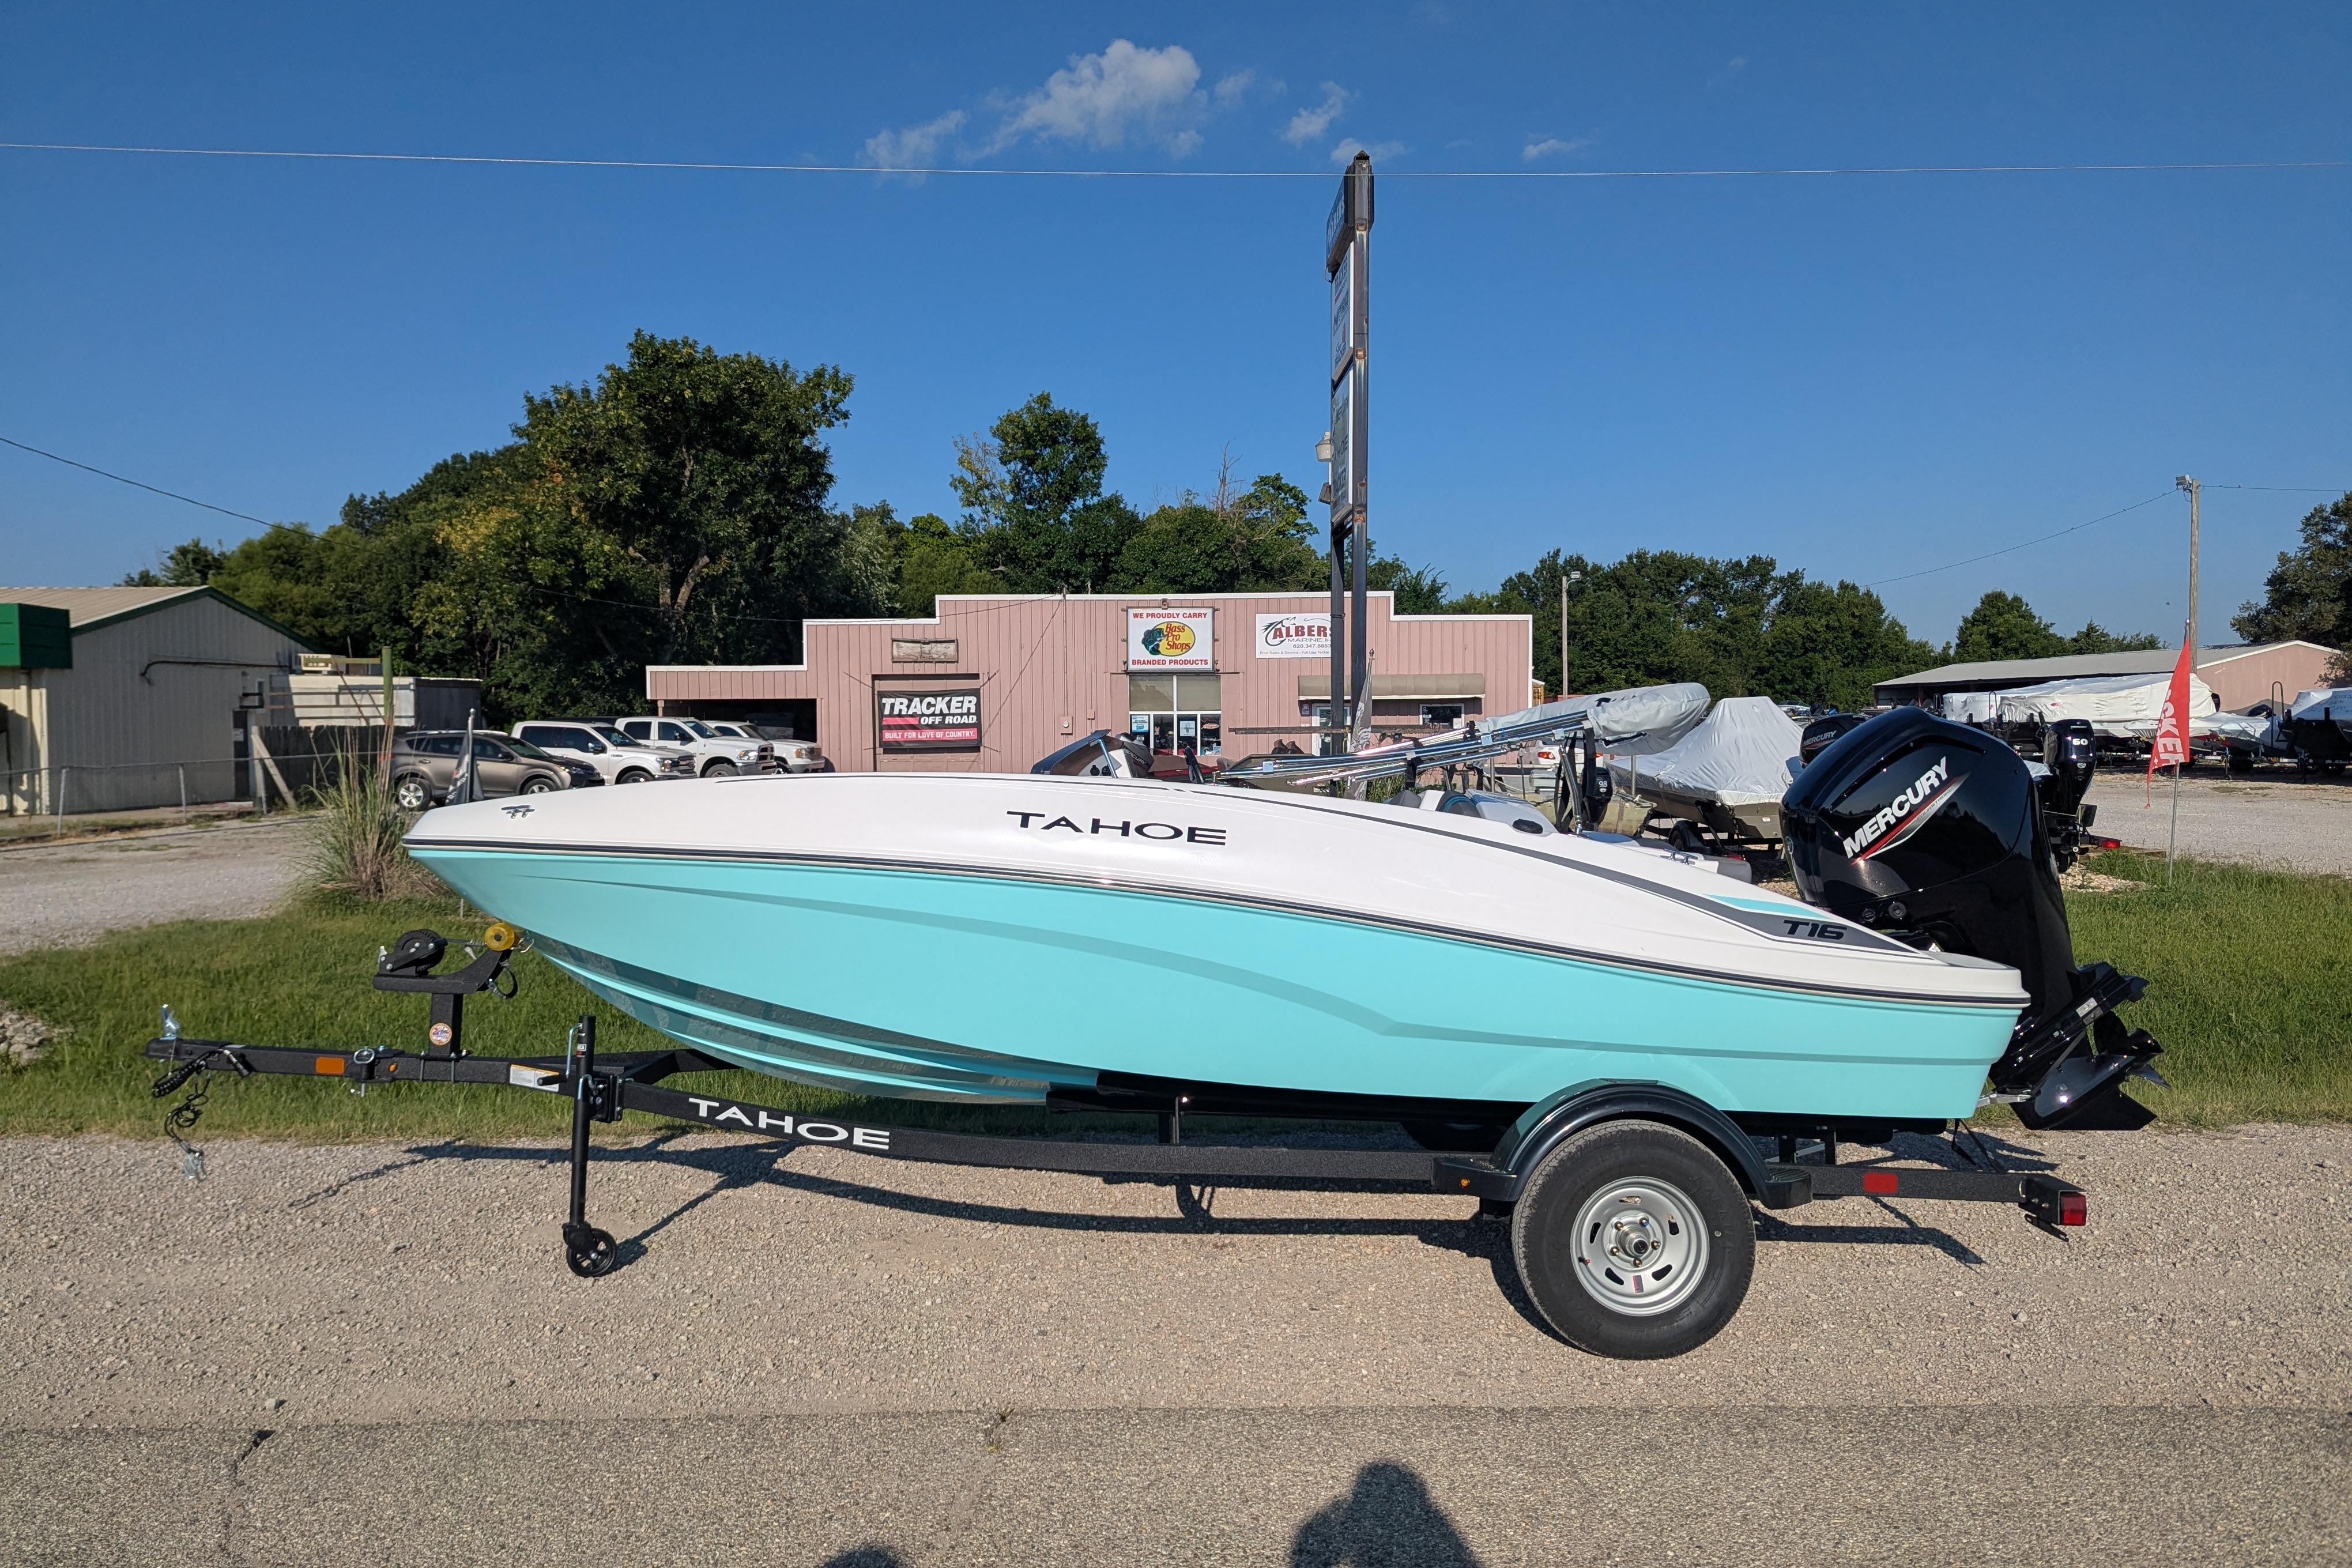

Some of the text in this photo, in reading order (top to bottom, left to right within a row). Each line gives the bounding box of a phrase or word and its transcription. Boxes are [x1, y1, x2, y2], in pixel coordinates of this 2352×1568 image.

[1165, 623, 1186, 633] Bass
[1272, 625, 1331, 640] ALBER
[1166, 632, 1181, 642] Pro
[1166, 640, 1191, 651] Shops
[881, 696, 977, 715] TRACKER
[921, 716, 943, 725] OFF
[1803, 730, 1837, 747] MERCURY
[1843, 756, 1948, 858] MERCURY
[1007, 811, 1227, 846] TAHOE
[1784, 919, 1848, 940] T16
[689, 1097, 889, 1150] TAHOE
